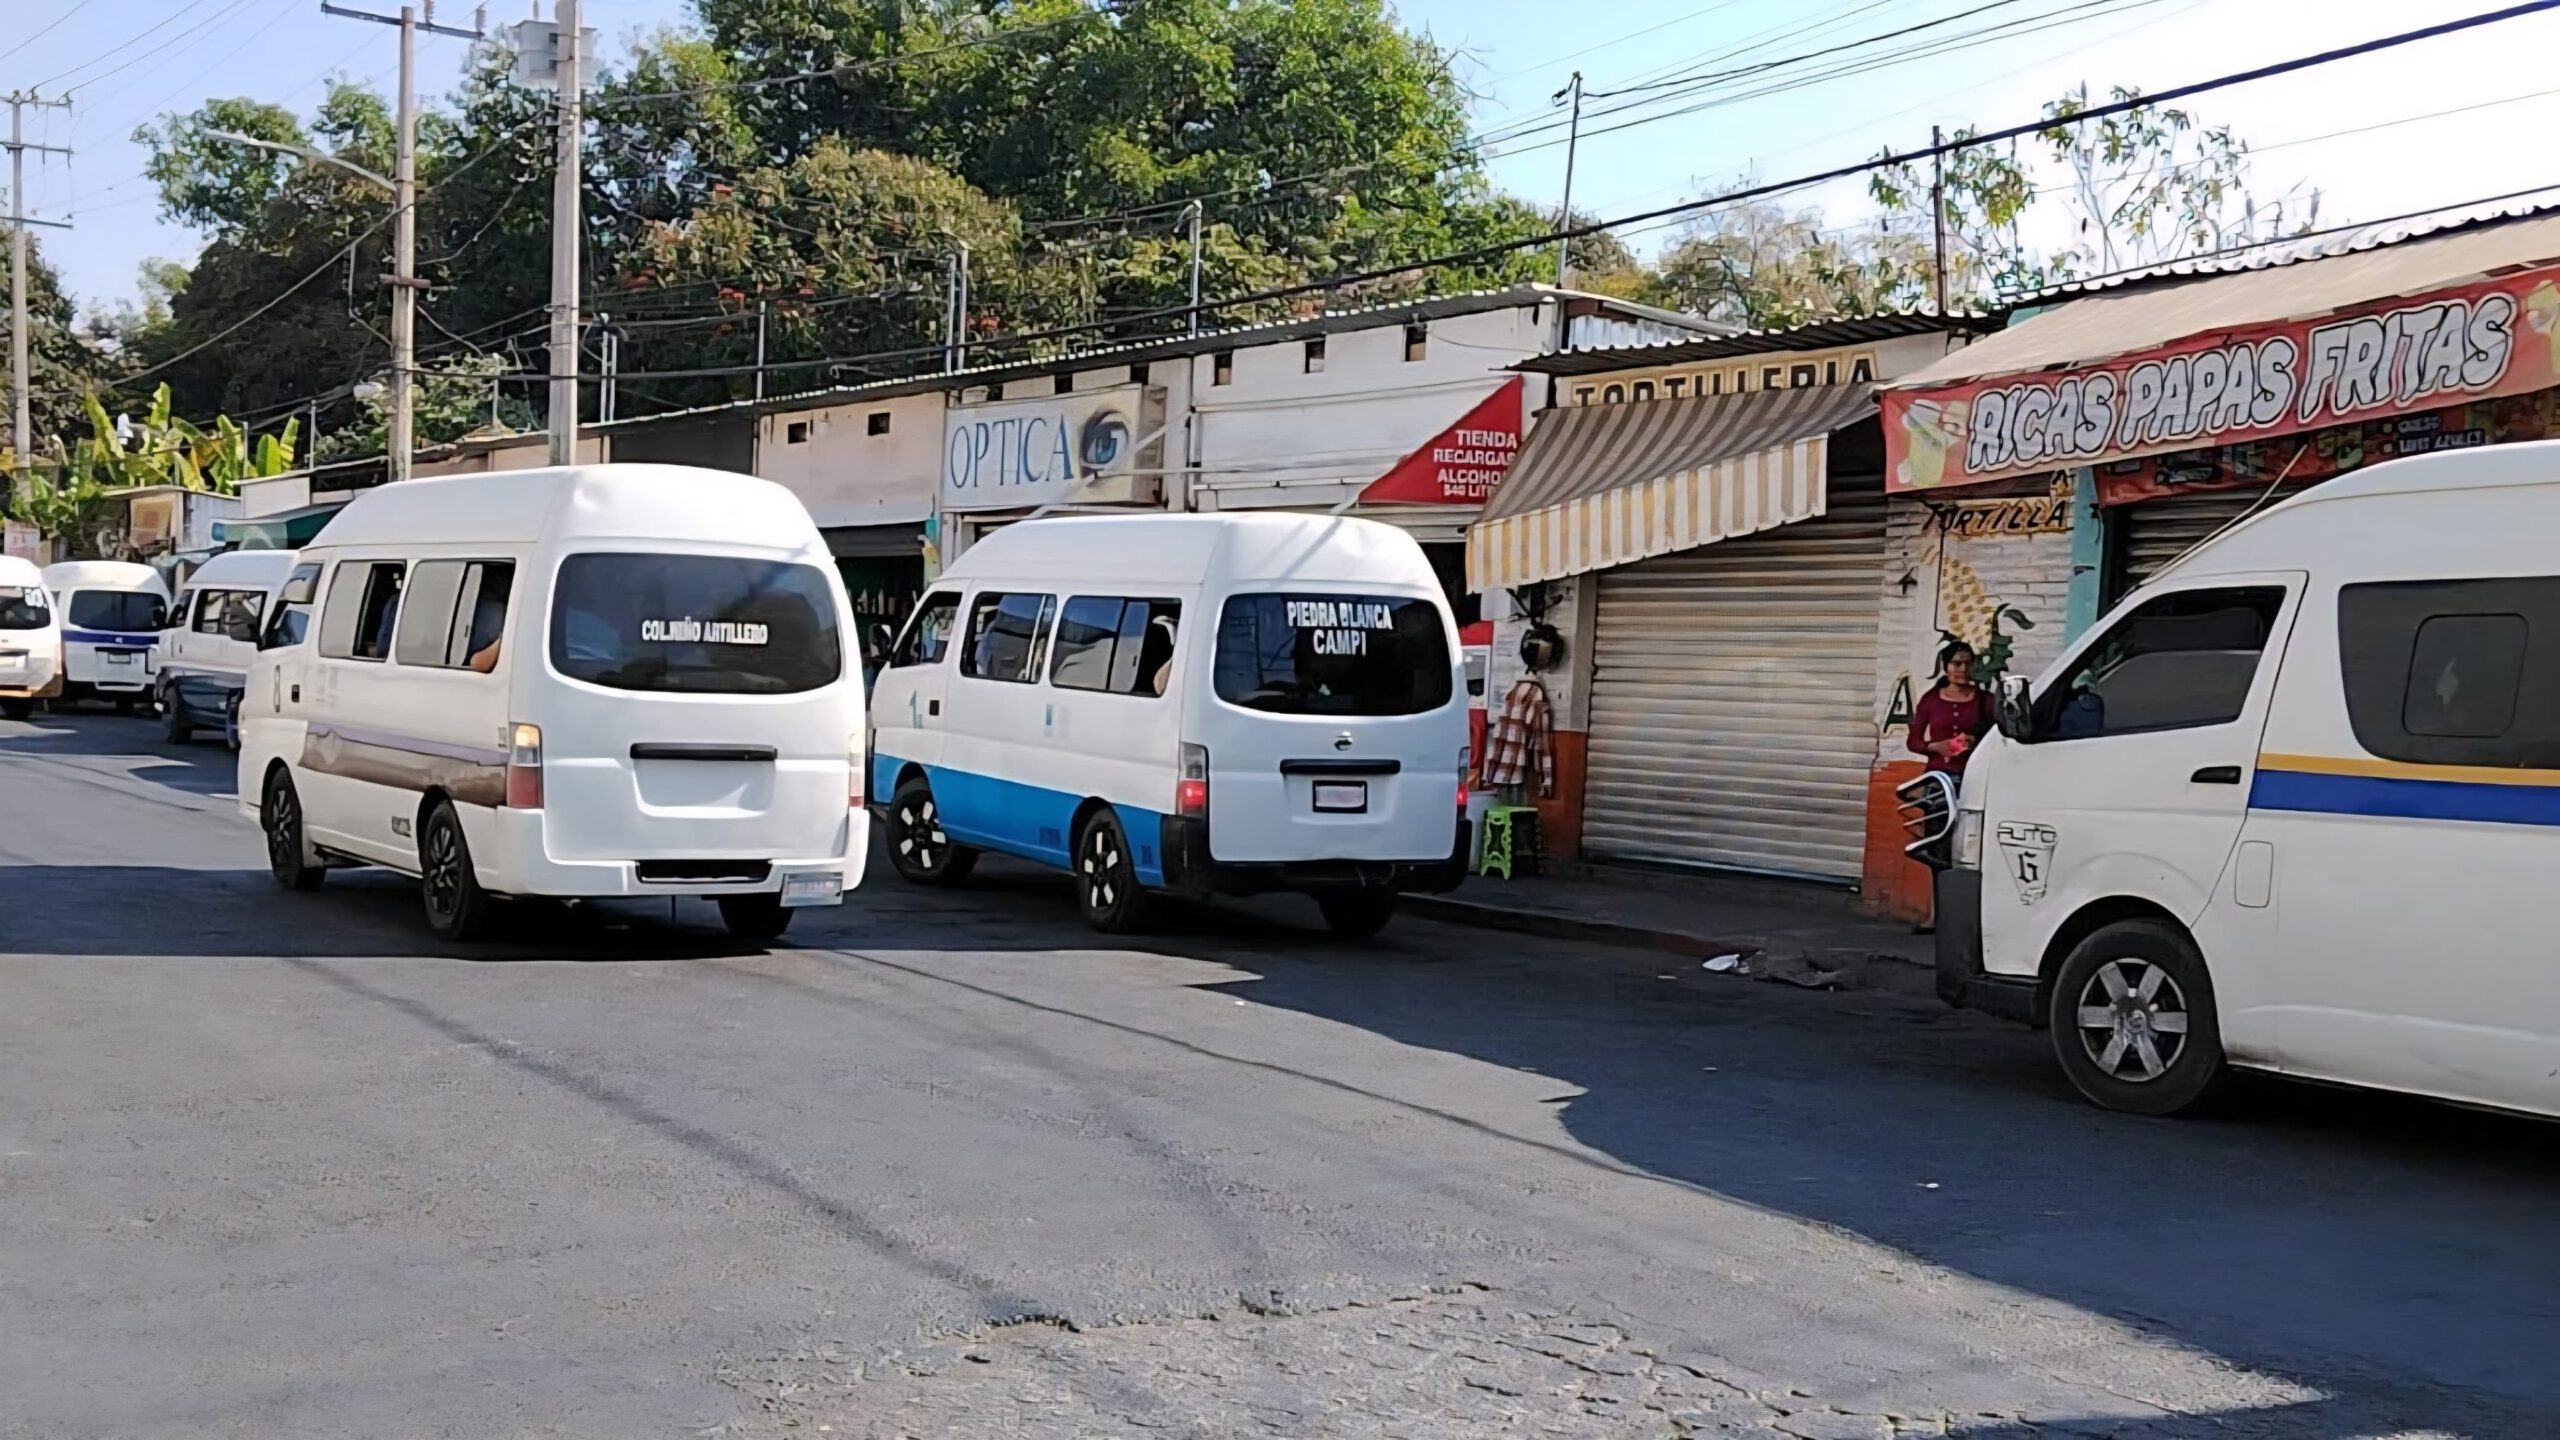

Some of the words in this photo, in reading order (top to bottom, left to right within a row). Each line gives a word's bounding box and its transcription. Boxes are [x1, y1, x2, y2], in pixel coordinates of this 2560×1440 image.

[1969, 373, 2116, 470] RICAS
[2121, 339, 2295, 447] PAPAS
[2301, 297, 2517, 422] FRITAS
[950, 413, 1075, 489] OPTICA
[1455, 429, 1518, 449] TIENDA
[1433, 448, 1516, 467] RECARGAS
[1437, 467, 1507, 485] ALCOHO
[1286, 601, 1338, 628] PIEDRA
[1339, 602, 1393, 630] BLANCA
[703, 621, 769, 645] ARTILLERO
[1312, 629, 1367, 656] CAMPI
